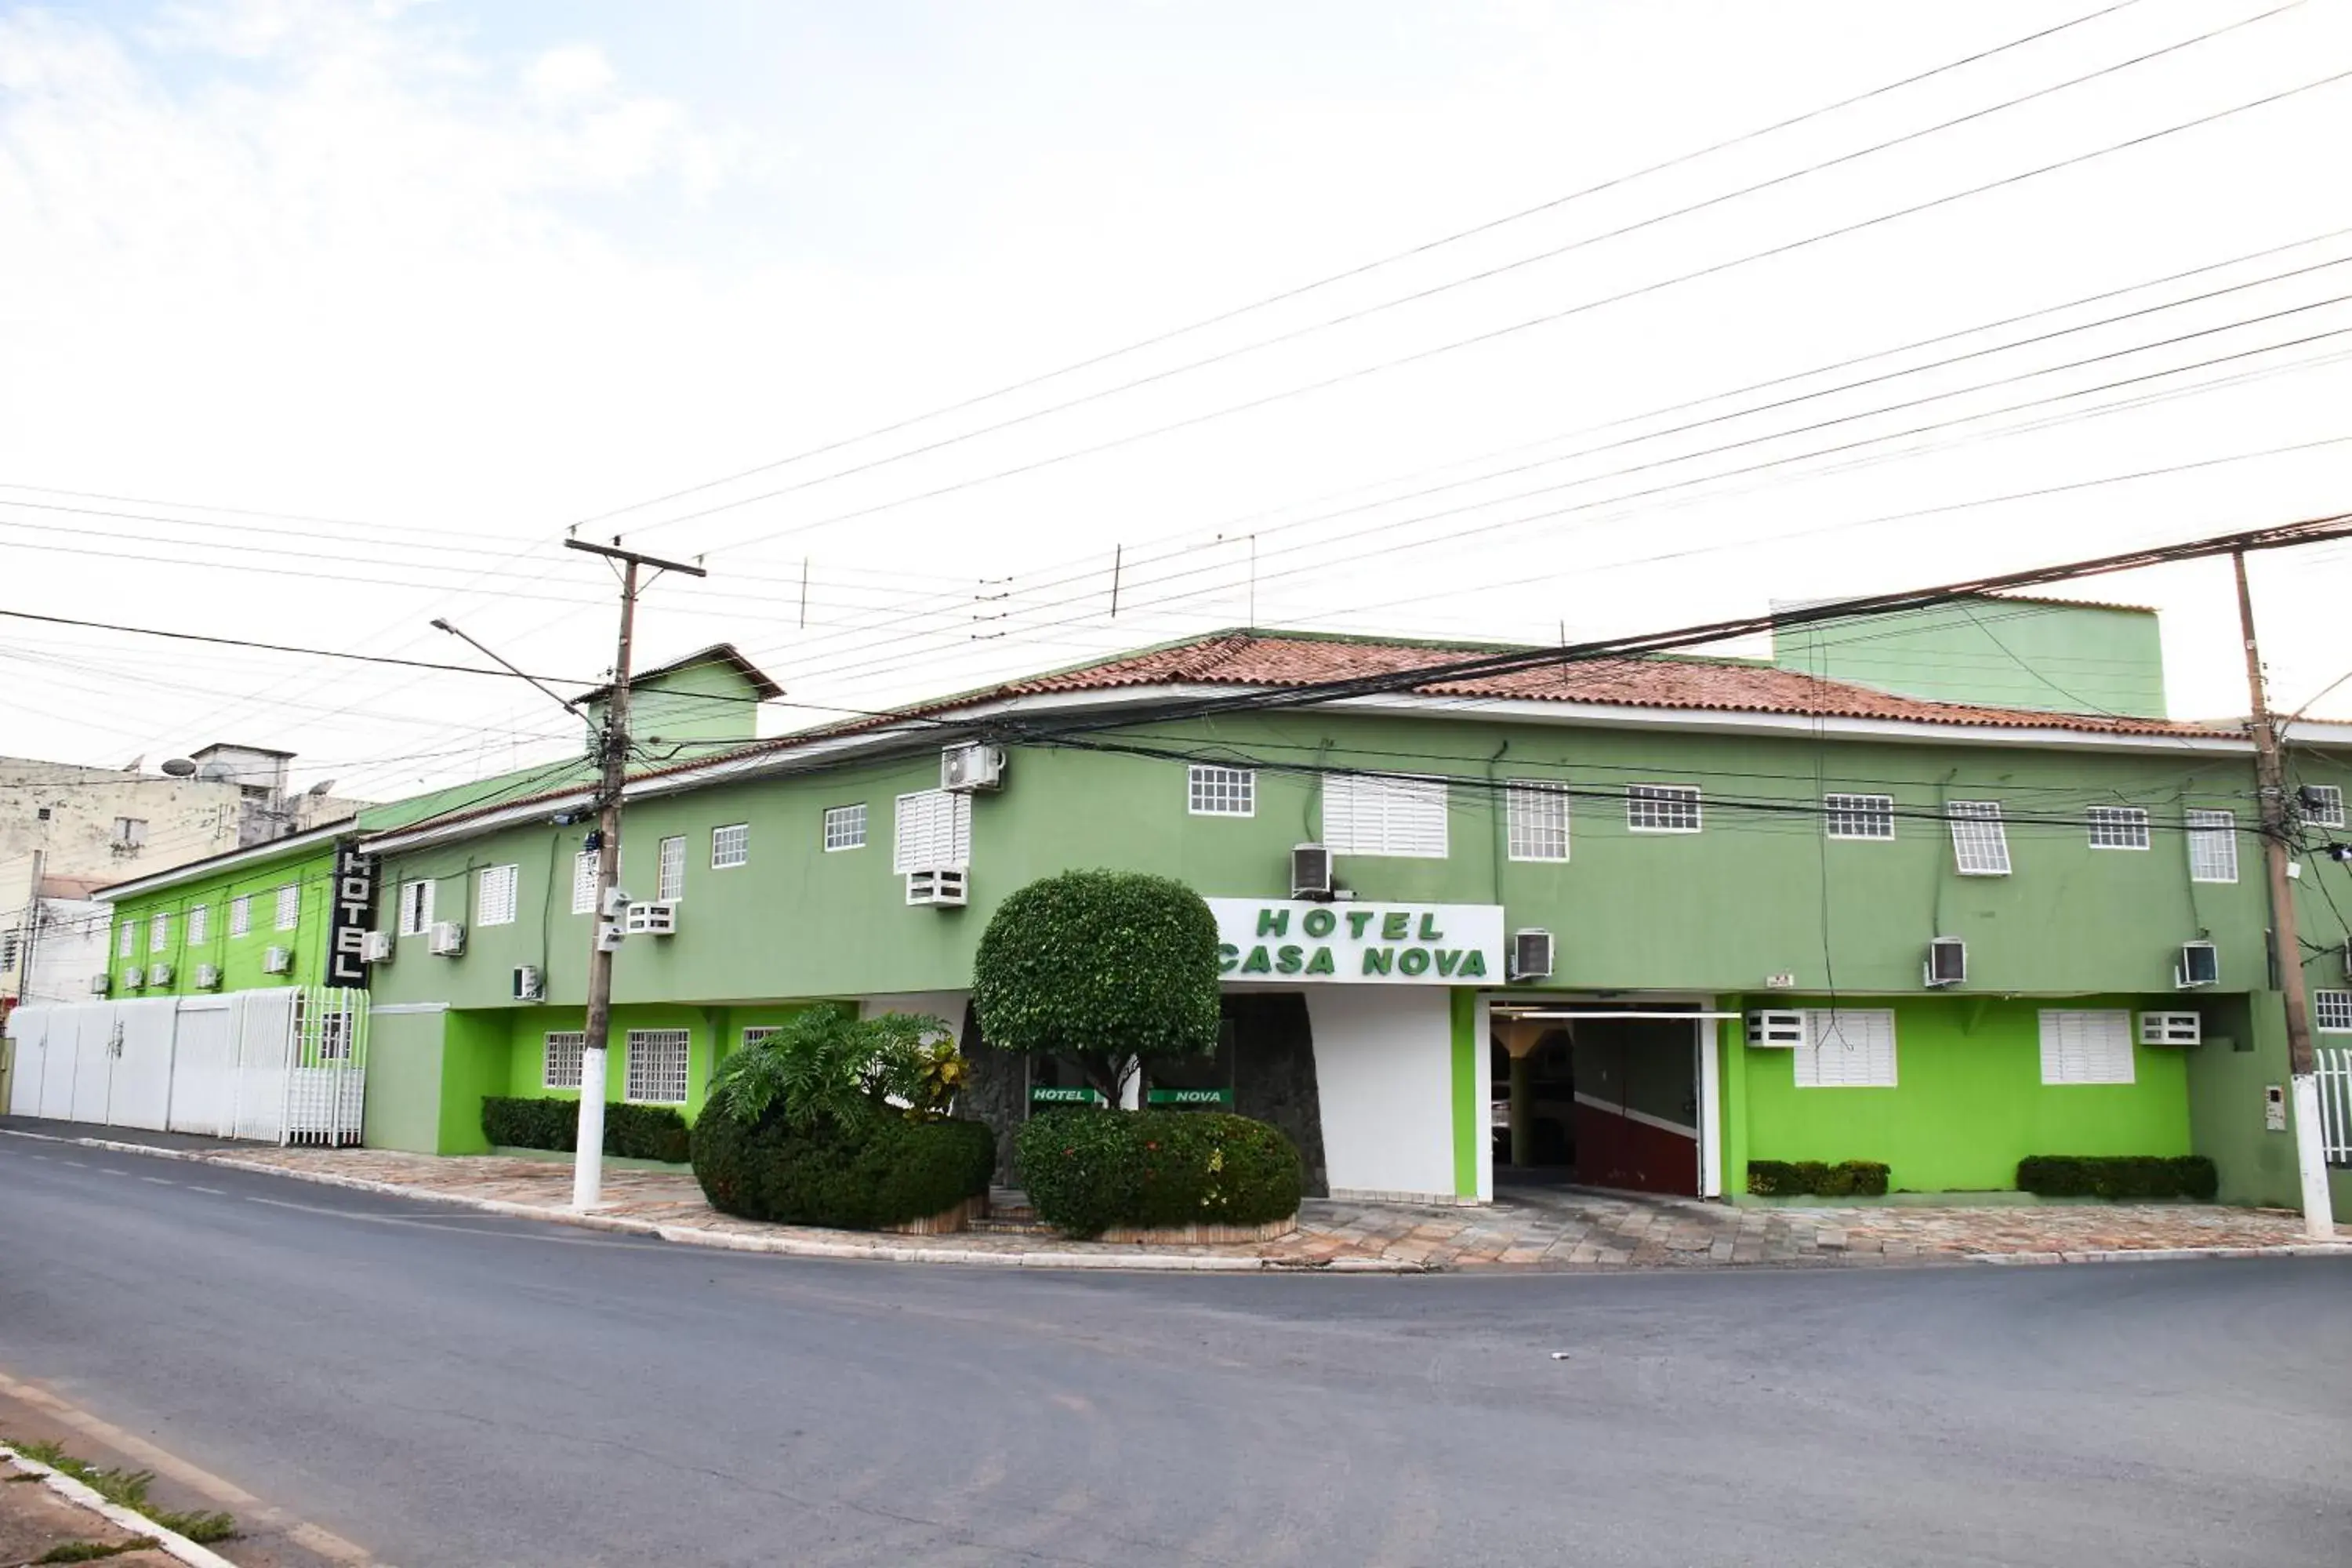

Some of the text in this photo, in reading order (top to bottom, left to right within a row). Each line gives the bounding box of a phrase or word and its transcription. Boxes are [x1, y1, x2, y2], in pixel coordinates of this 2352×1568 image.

[335, 851, 371, 978] HOTEL
[1256, 908, 1443, 940] HOTEL
[1218, 943, 1487, 977] CASA NOVA
[1034, 1089, 1086, 1101] HOTEL
[1176, 1090, 1221, 1102] NOVA
